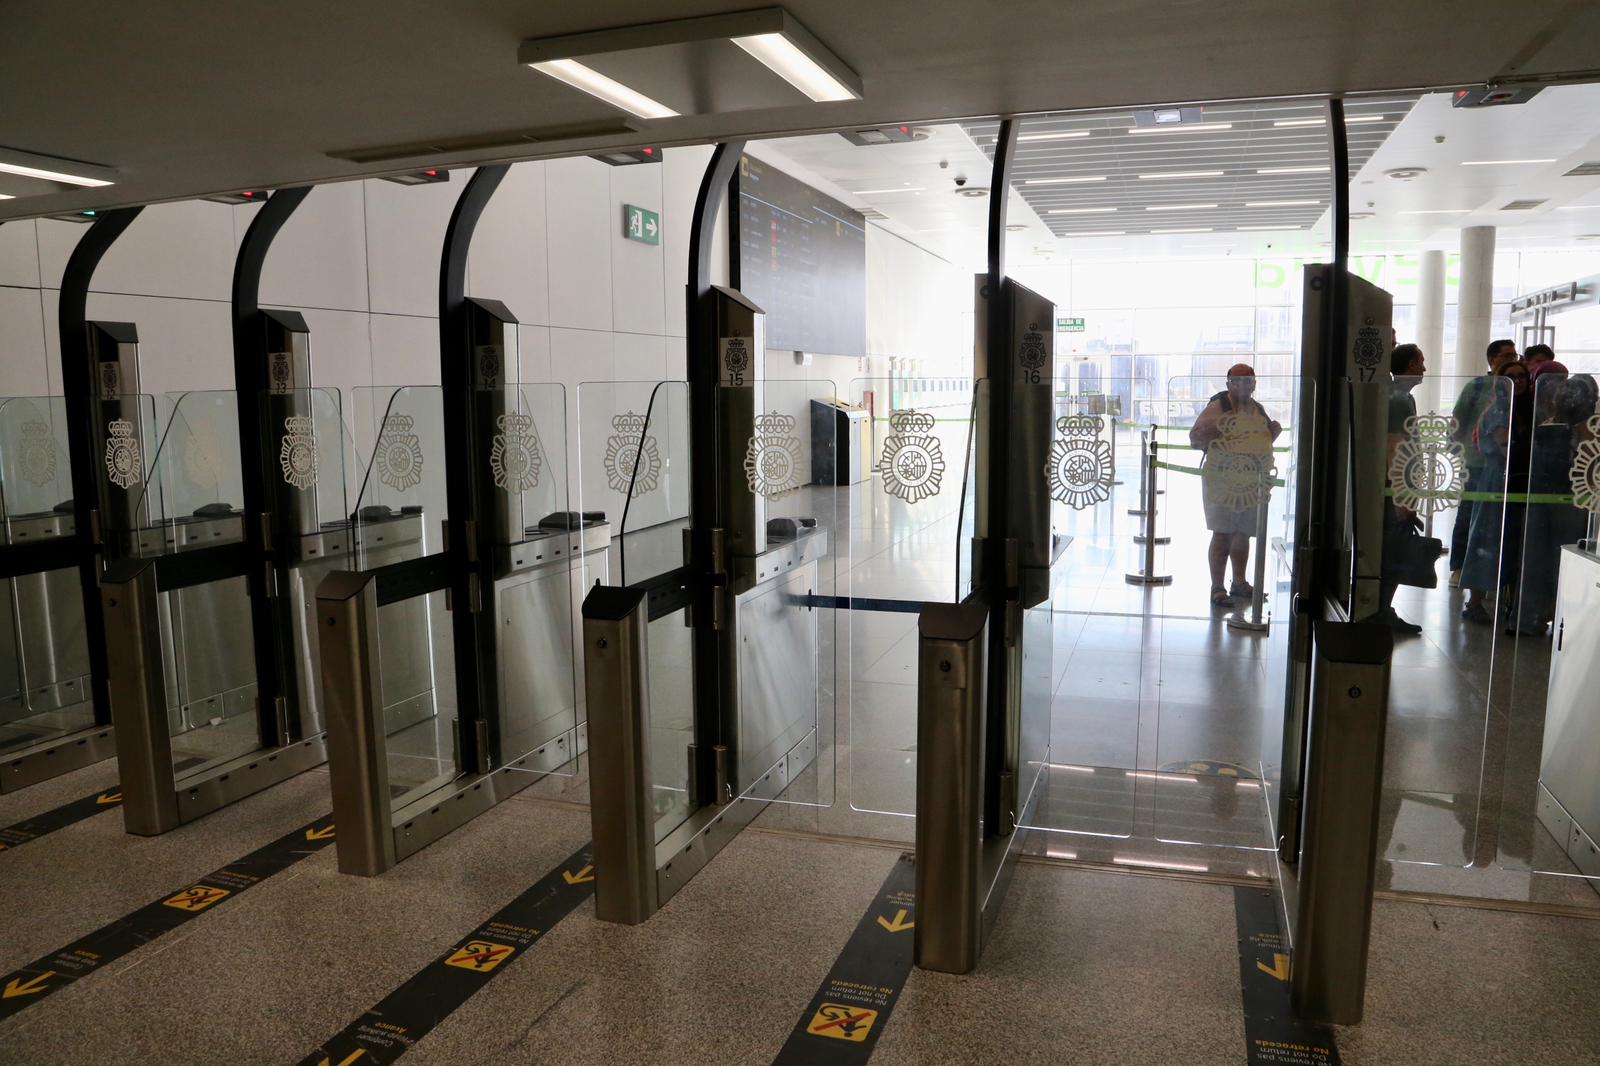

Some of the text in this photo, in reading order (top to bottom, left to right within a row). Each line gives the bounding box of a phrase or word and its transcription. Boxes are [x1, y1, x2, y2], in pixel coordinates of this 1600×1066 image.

[730, 374, 744, 386] 15
[1024, 370, 1040, 384] 16
[1358, 368, 1376, 382] 17
[276, 383, 286, 394] 13
[483, 378, 496, 390] 14
